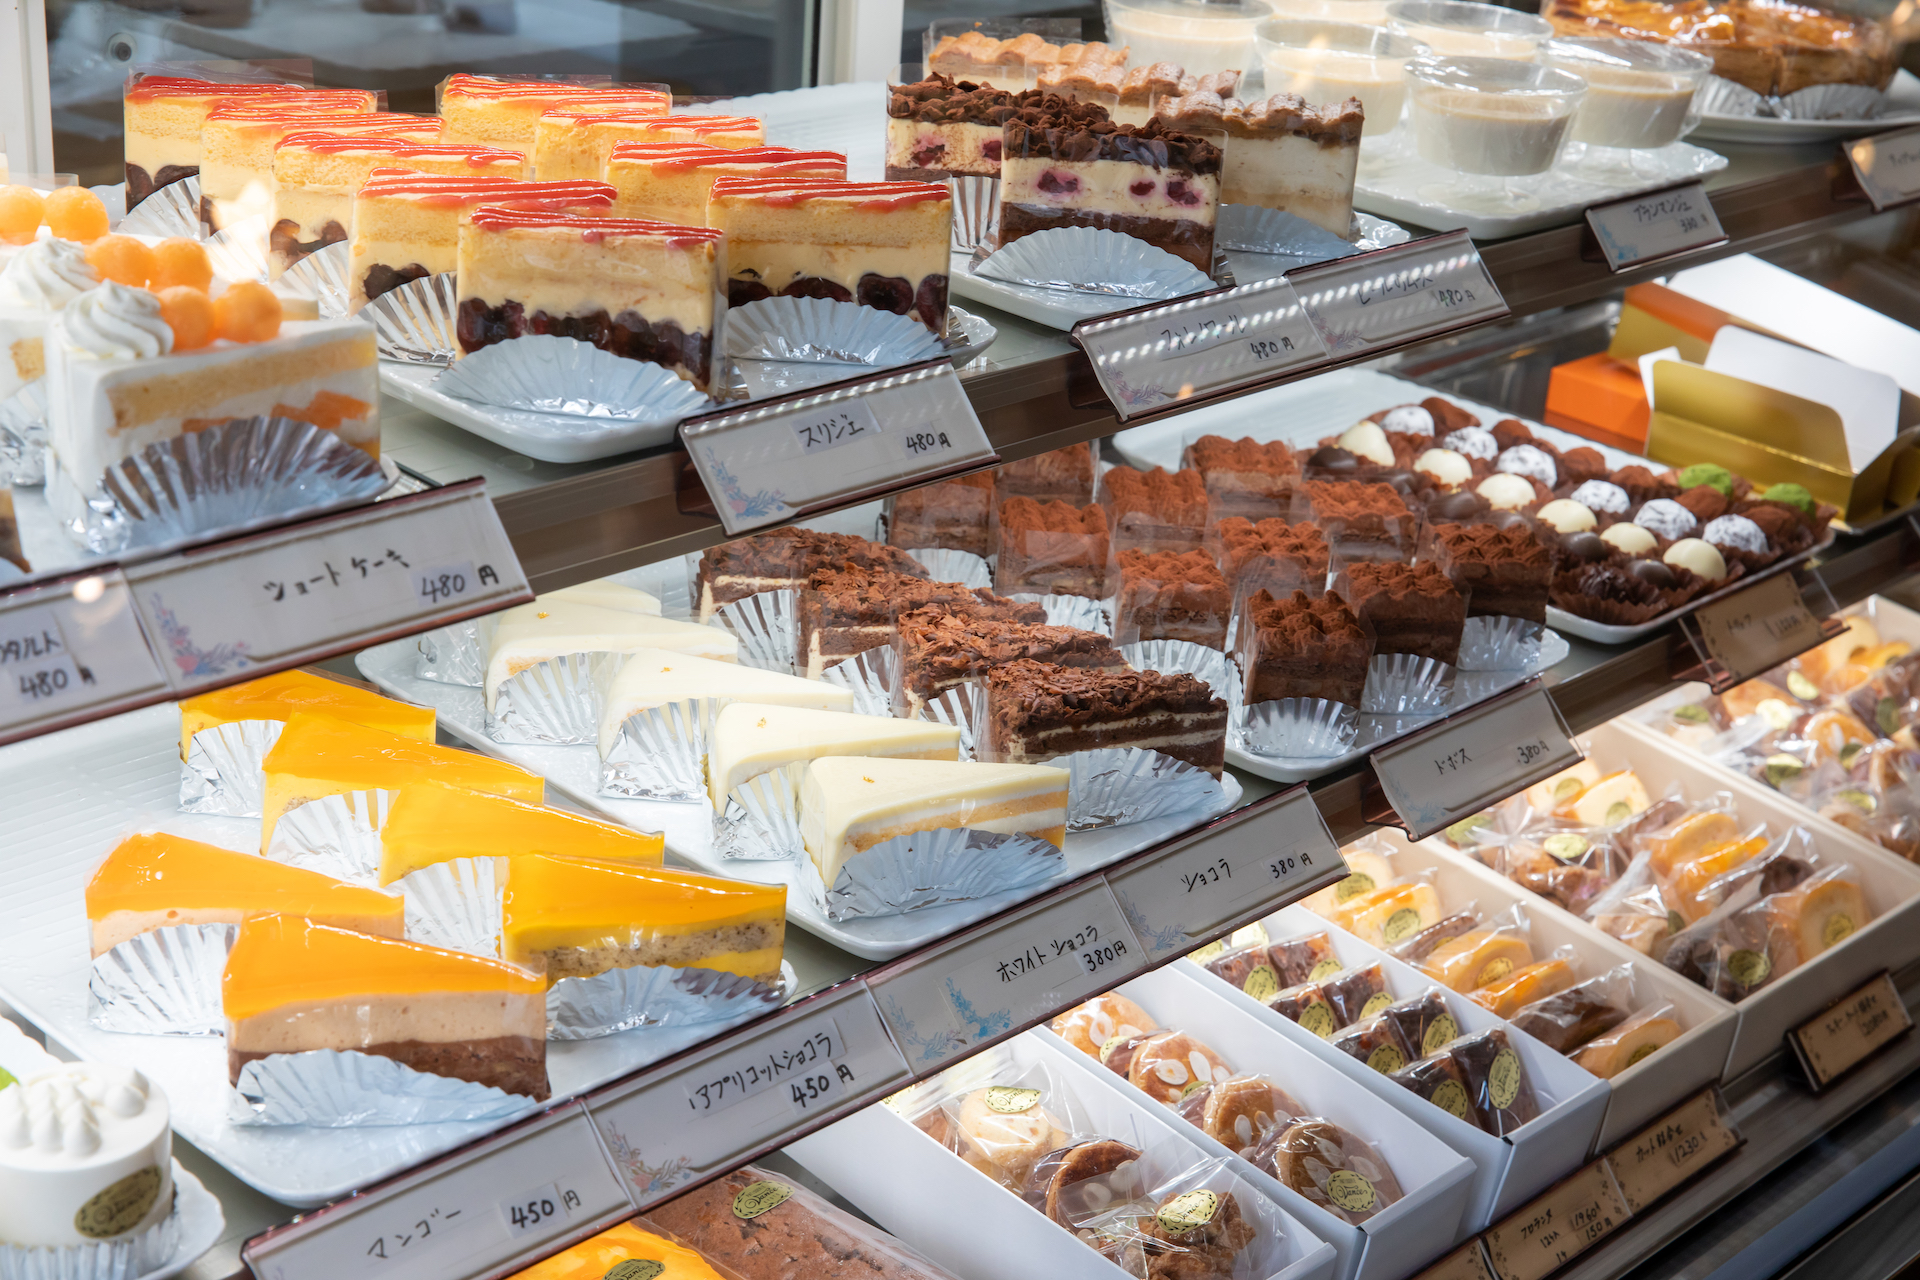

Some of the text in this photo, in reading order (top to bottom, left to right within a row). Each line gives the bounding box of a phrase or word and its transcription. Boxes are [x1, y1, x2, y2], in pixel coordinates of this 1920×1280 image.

[0, 630, 61, 663] タルト
[1180, 858, 1232, 893] ショコラ
[367, 1208, 462, 1259] マンゴー
